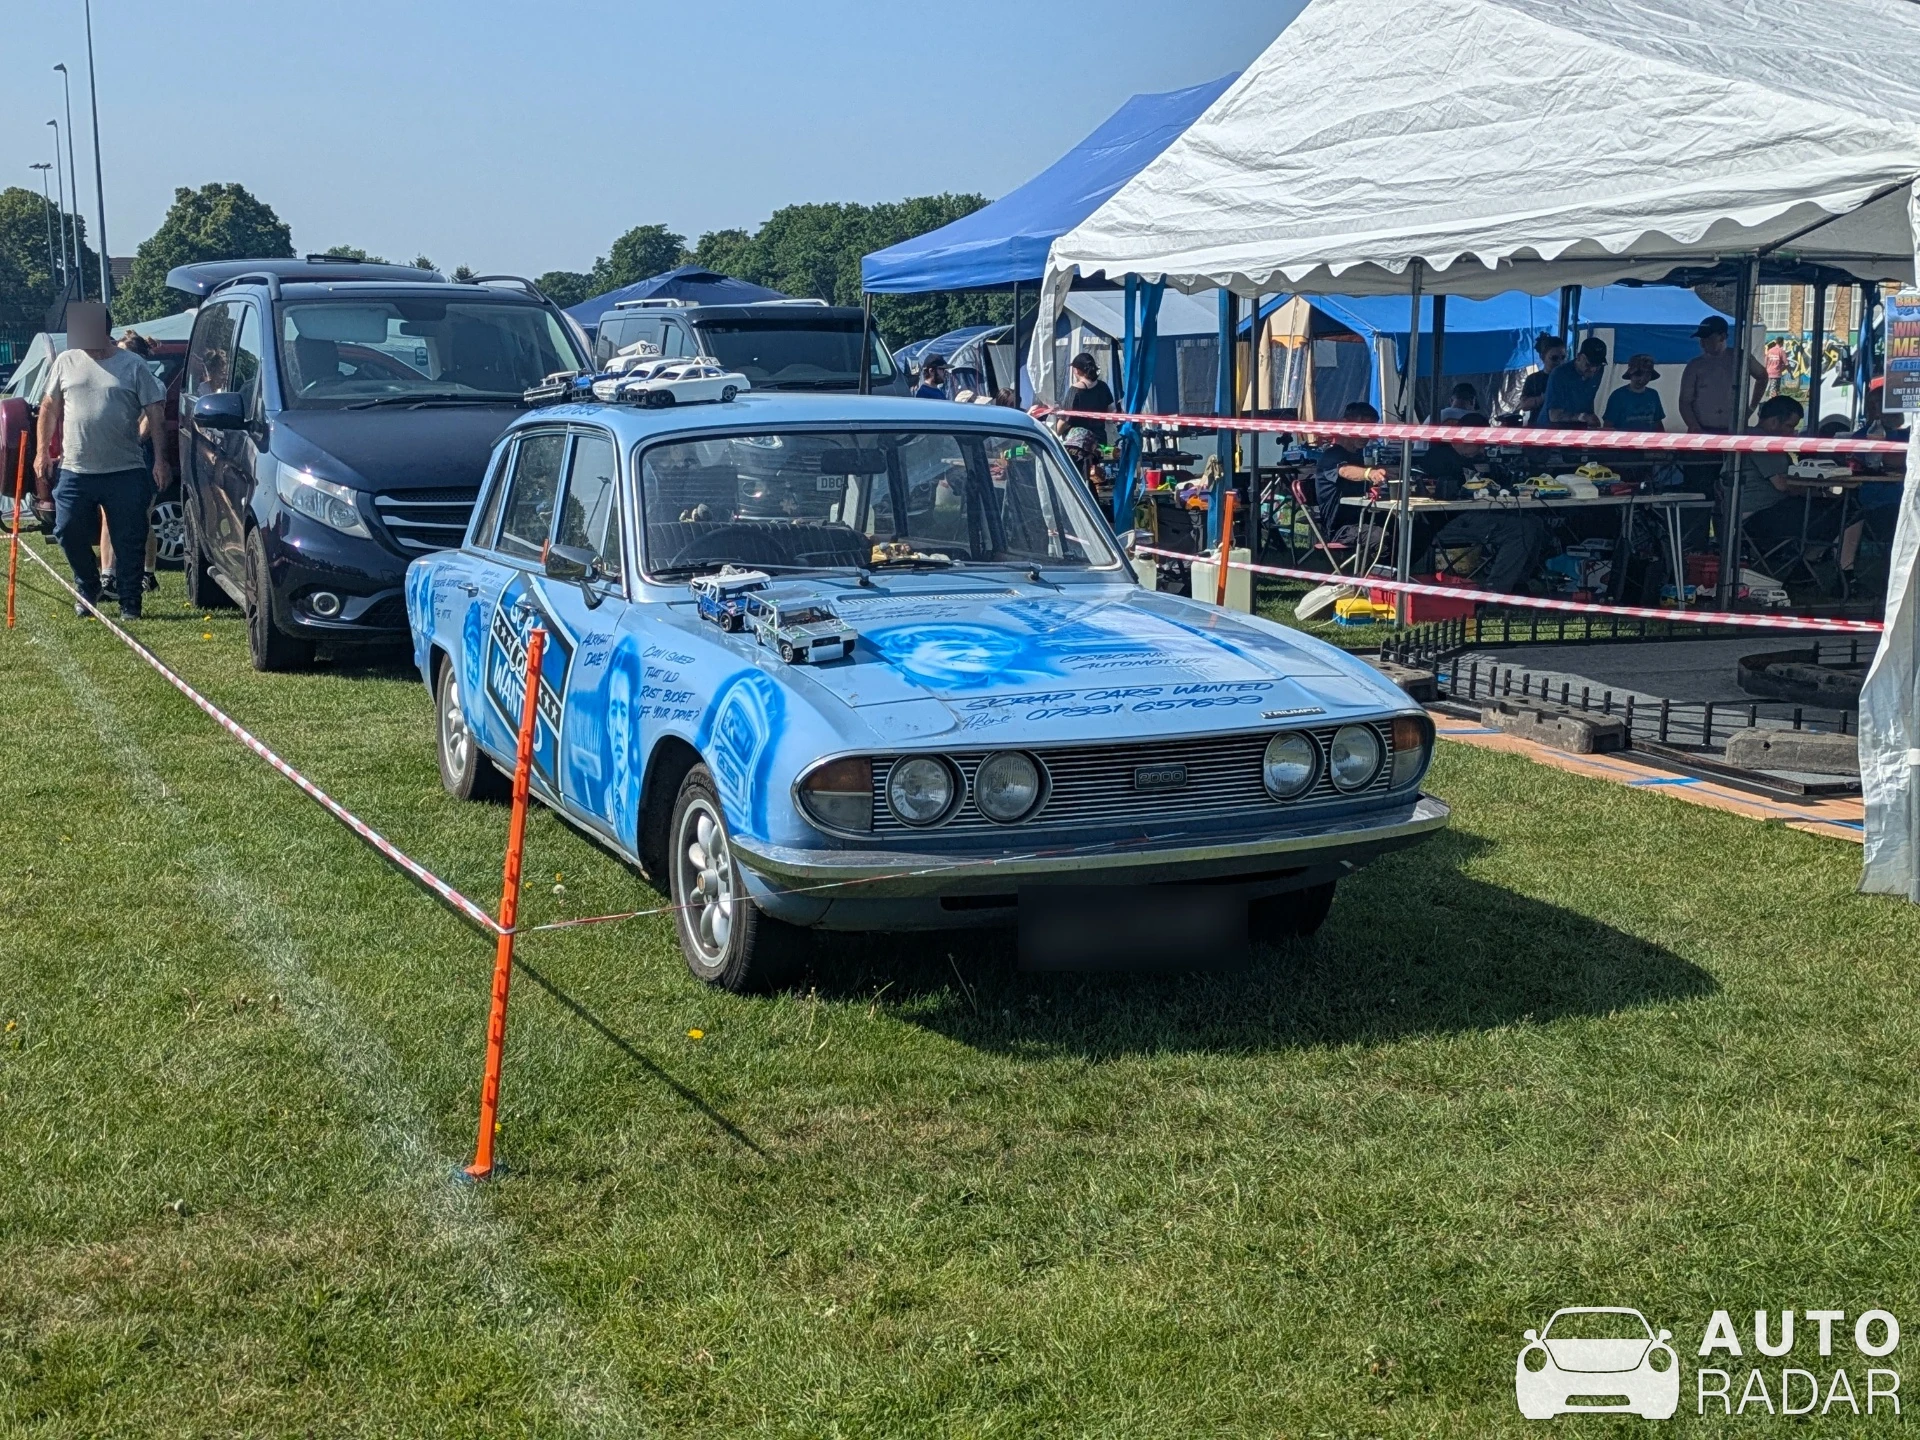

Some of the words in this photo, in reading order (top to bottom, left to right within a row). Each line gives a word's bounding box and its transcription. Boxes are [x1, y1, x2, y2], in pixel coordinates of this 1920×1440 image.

[1893, 337, 1920, 357] ME
[1072, 658, 1210, 671] AUTOMOTIVE
[644, 666, 664, 680] THAT
[662, 670, 680, 683] OLD
[493, 651, 543, 752] WANTD
[640, 685, 663, 701] RUST
[662, 689, 696, 706] BUCKET
[960, 692, 1076, 711] SCRAP
[1084, 687, 1163, 701] CARS
[1173, 682, 1274, 696] WANTED
[1132, 695, 1263, 713] 657699
[1266, 707, 1322, 717] TRIUMPH
[1138, 770, 1184, 785] 2000
